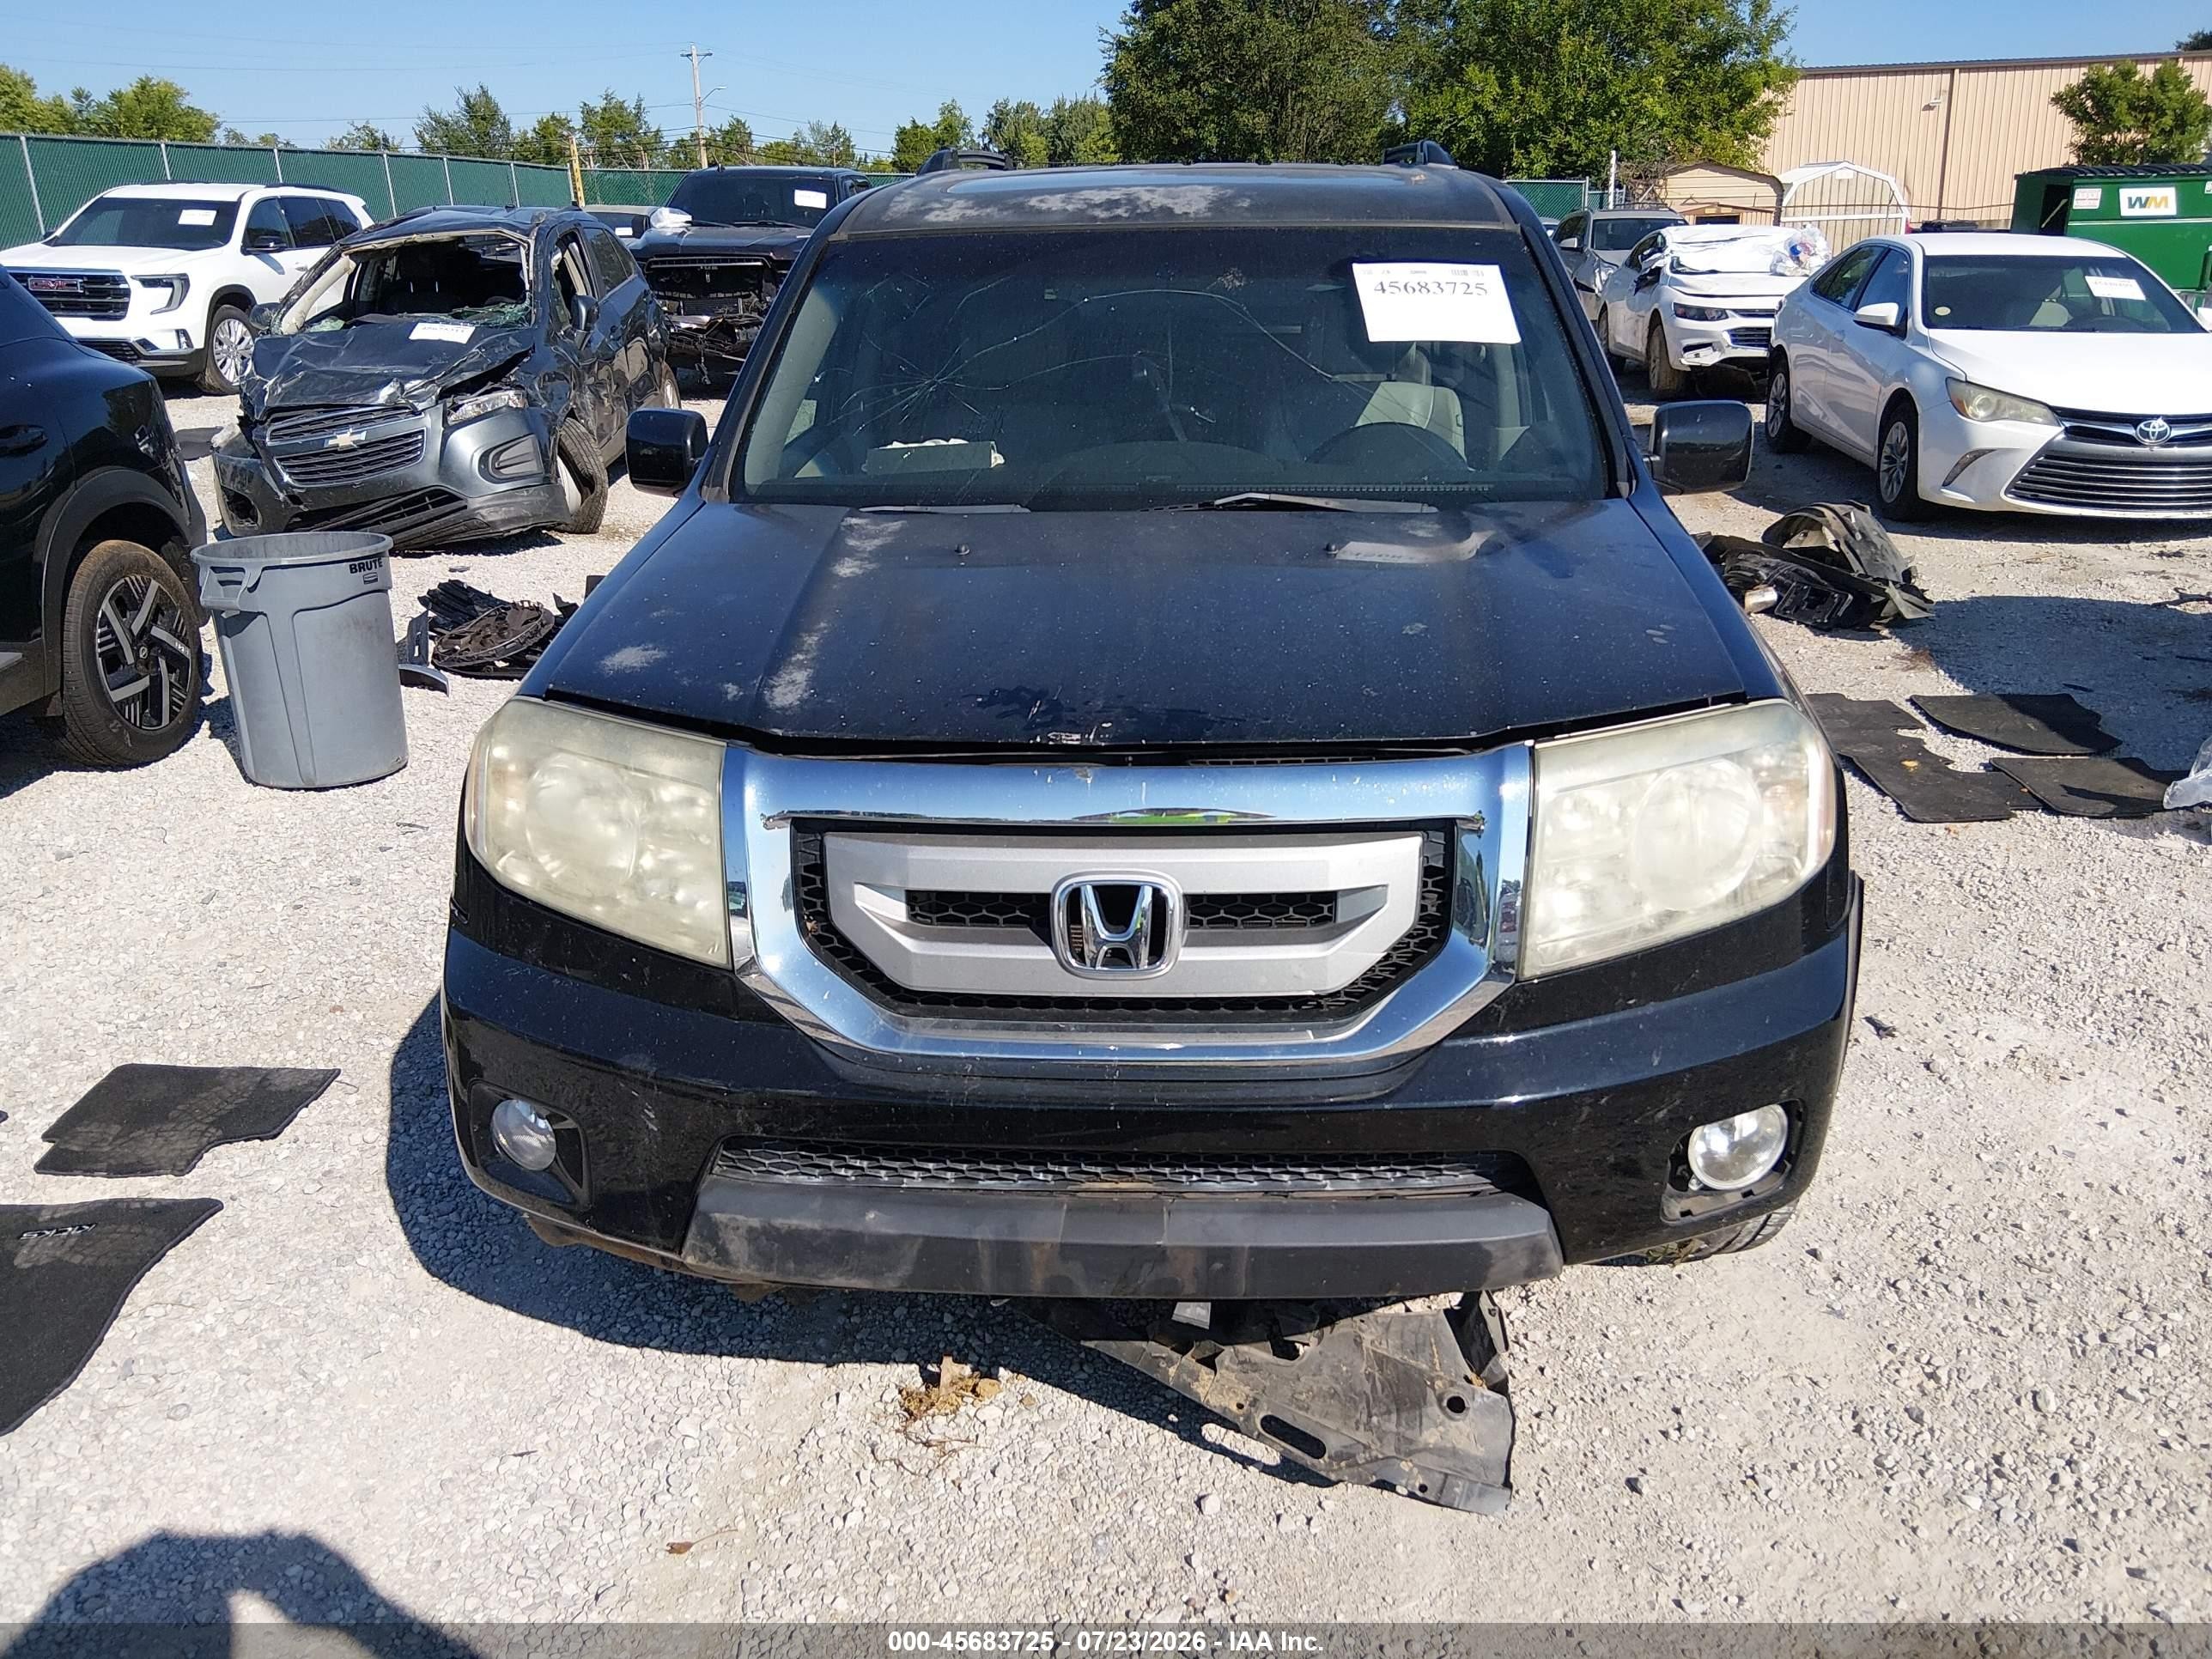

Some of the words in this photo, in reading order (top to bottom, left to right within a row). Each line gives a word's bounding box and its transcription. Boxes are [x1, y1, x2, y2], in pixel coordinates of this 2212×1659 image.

[2127, 196, 2169, 209] WM
[33, 280, 77, 290] GMC
[1374, 281, 1488, 295] 45683725
[349, 557, 383, 574] BRUTE
